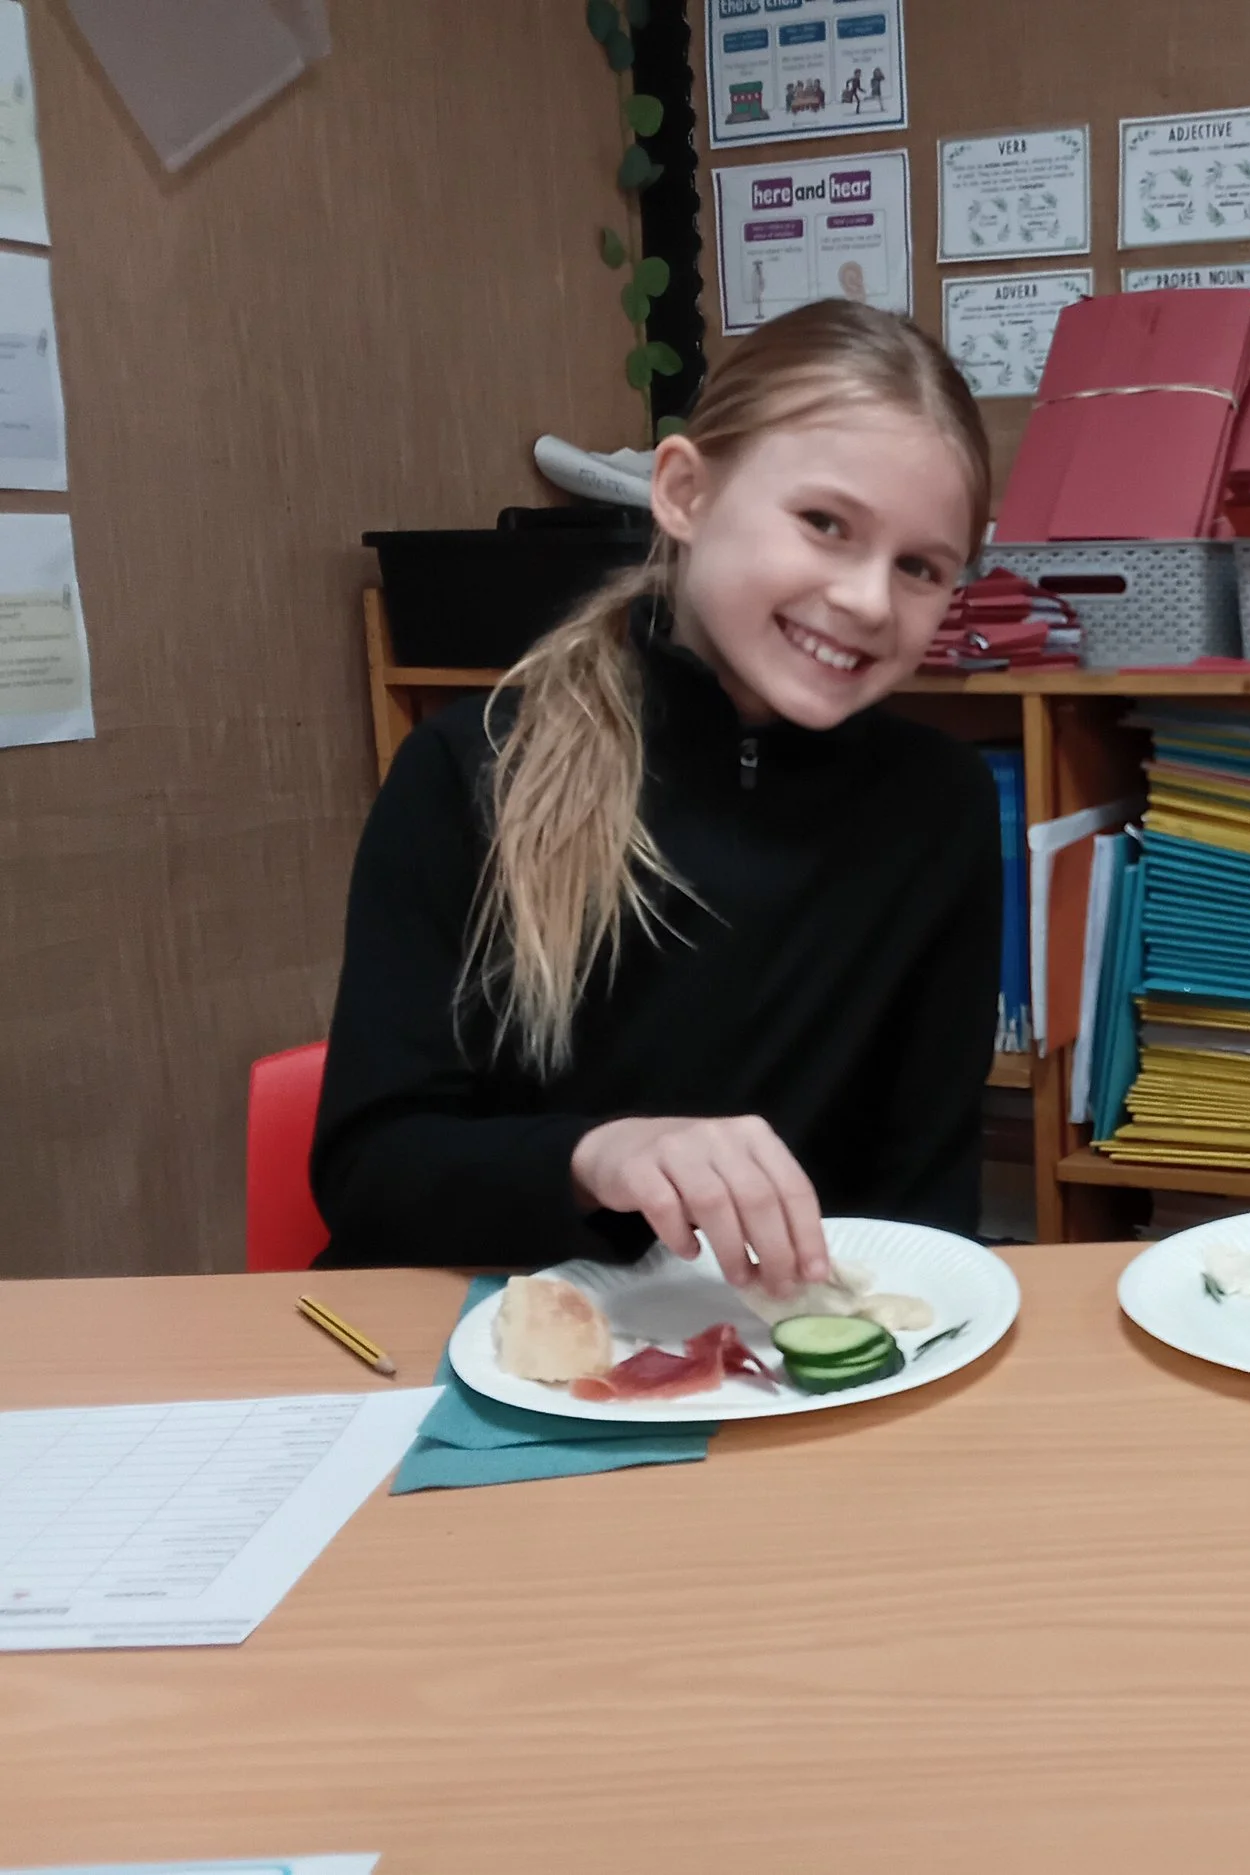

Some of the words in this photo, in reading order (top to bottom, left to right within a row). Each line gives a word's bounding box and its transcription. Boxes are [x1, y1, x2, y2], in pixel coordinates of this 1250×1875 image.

[1168, 121, 1233, 142] ADJECTIVE
[998, 139, 1027, 156] VERB
[753, 183, 791, 205] here
[795, 178, 825, 201] and
[830, 177, 870, 200] hear
[1157, 271, 1202, 289] PROPER
[1209, 270, 1245, 286] NOUN
[994, 283, 1038, 300] ADVERB
